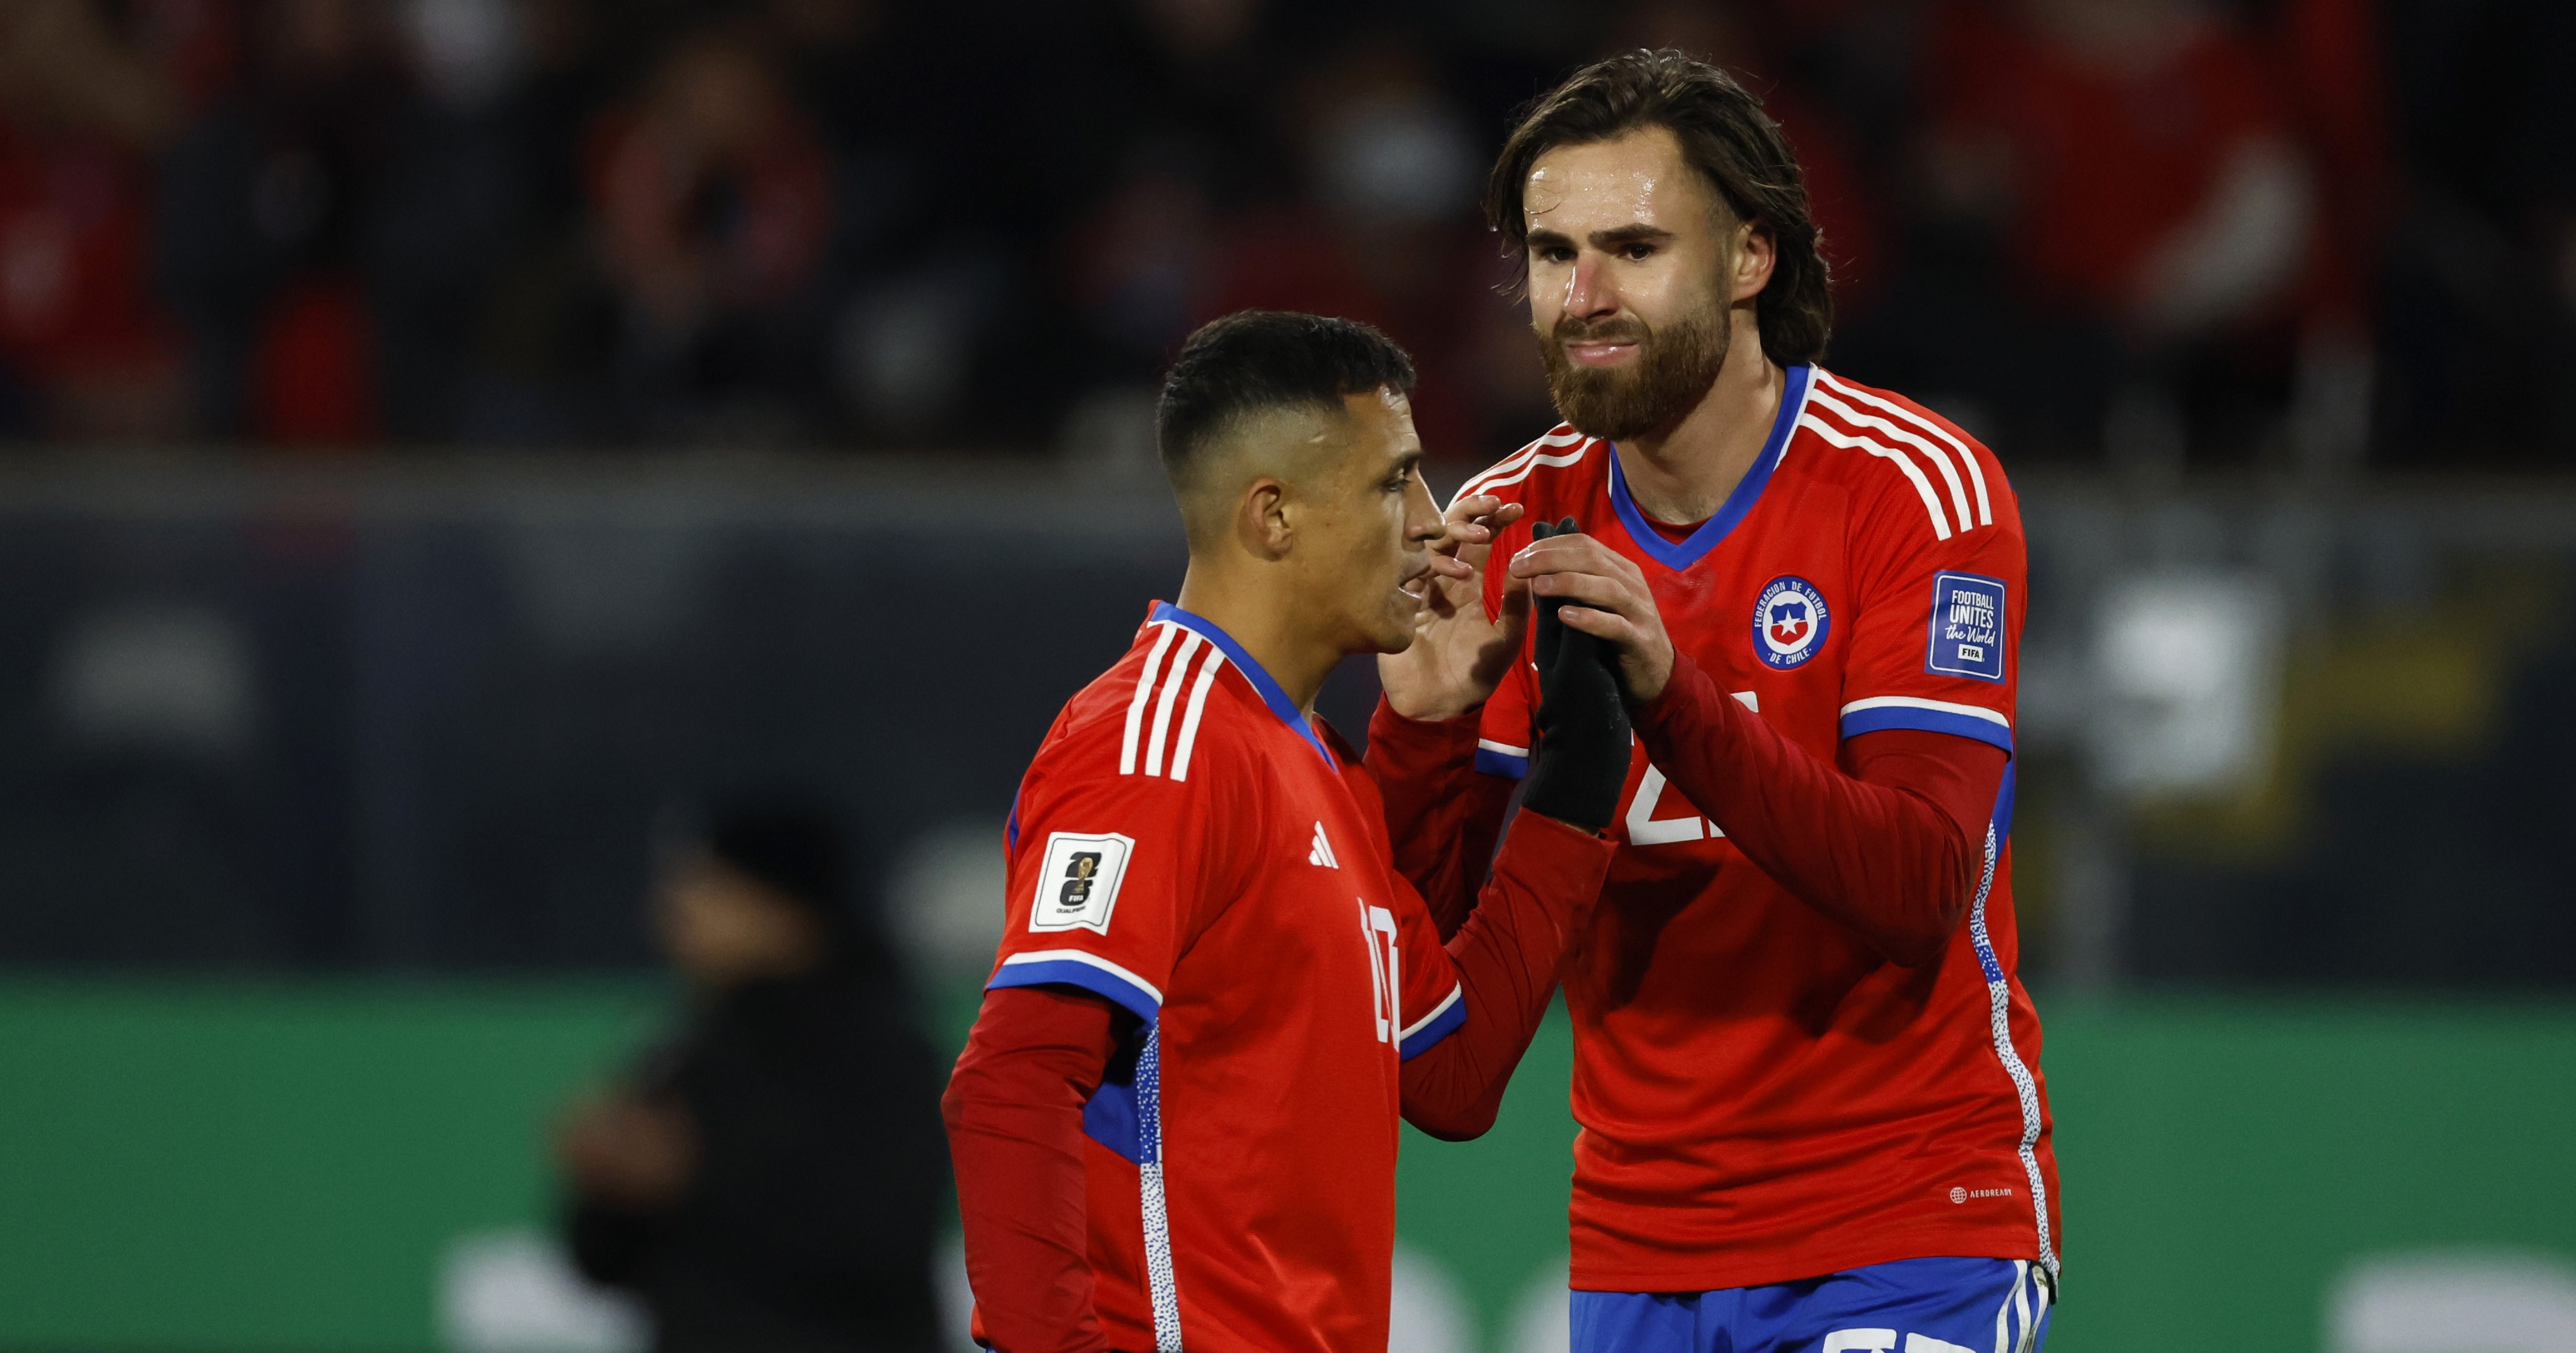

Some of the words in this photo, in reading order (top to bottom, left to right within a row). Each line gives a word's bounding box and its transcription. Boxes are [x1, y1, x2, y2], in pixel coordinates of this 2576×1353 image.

[1755, 582, 1785, 627] FEDERACION
[1792, 581, 1802, 592] DE
[1805, 588, 1827, 620] FUTBOL
[1951, 590, 1994, 609] FOOTBALL
[1950, 605, 1993, 629] UNITES
[1945, 624, 1966, 639] the
[1967, 627, 1996, 647] World
[1770, 653, 1782, 664] DE
[1786, 648, 1810, 664] CHILE
[1962, 648, 1980, 659] FIFA
[1970, 1189, 2012, 1198] AEROREADY
